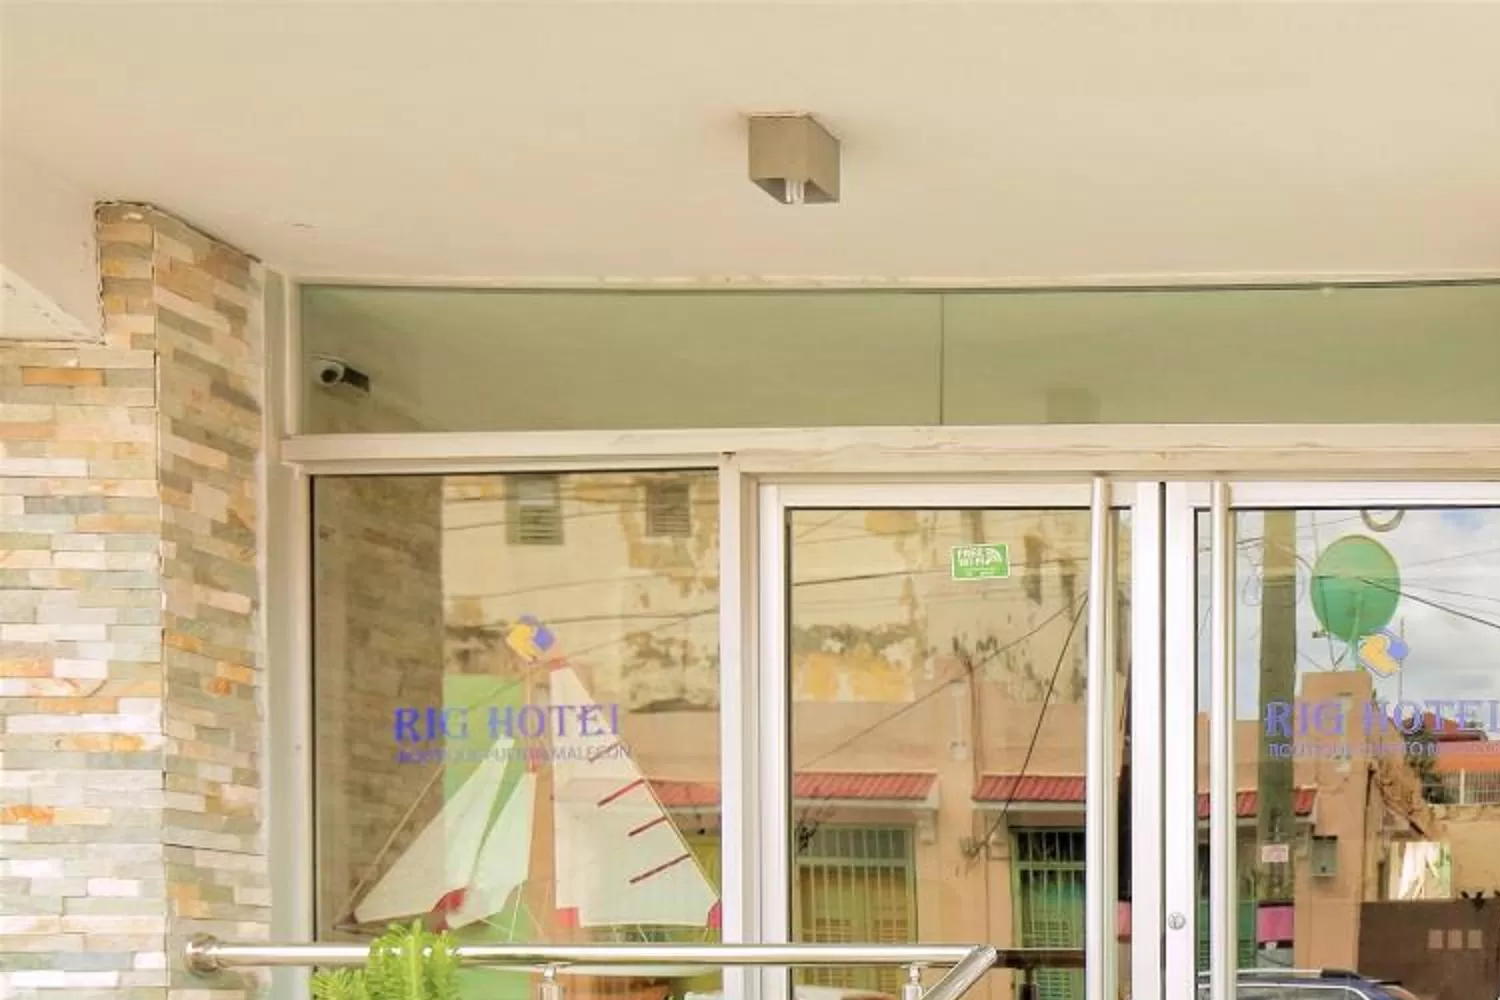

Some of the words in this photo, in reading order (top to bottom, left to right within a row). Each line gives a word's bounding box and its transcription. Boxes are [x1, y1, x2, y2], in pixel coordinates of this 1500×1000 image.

[393, 706, 470, 743] RIG
[488, 703, 624, 738] HOTEL
[1265, 698, 1345, 736] RIG
